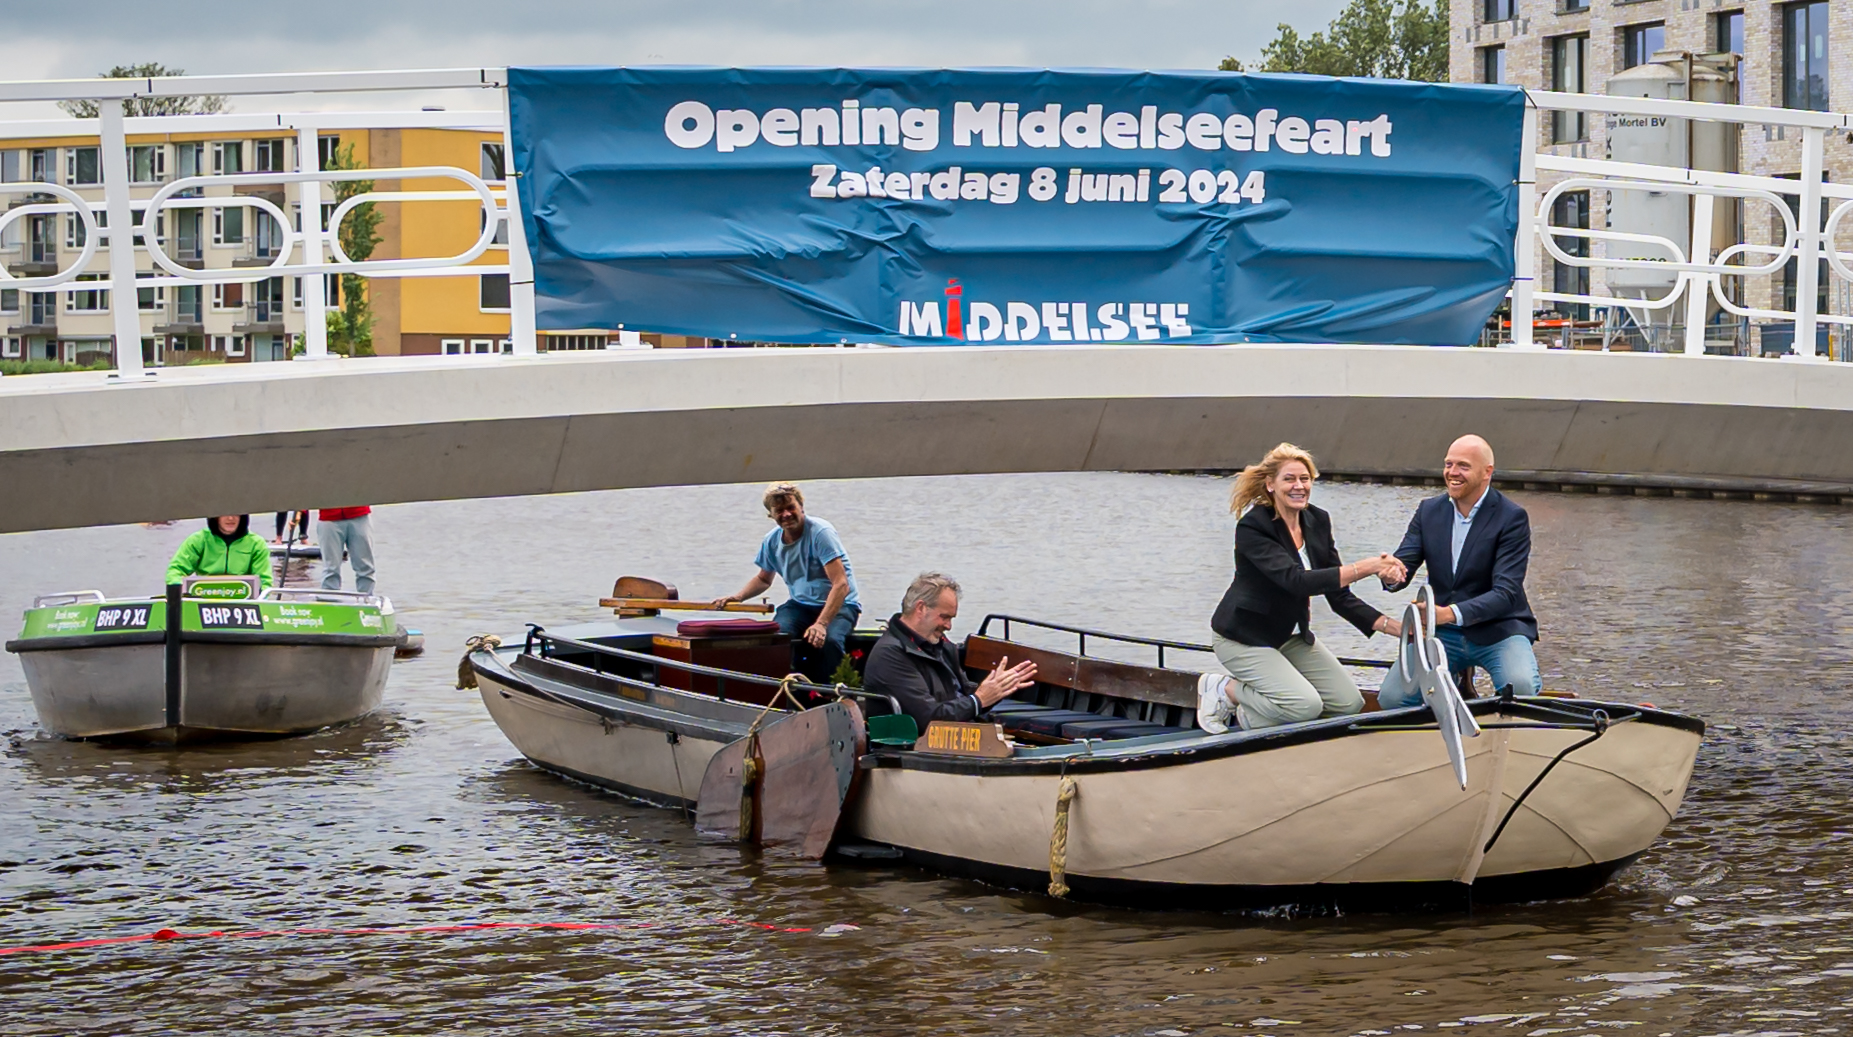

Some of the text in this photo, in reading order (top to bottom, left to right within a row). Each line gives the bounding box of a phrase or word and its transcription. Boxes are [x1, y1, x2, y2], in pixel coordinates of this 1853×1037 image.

[664, 99, 1393, 158] Opening Middelseefeart
[1618, 117, 1648, 128] Mortel
[1650, 117, 1667, 128] BV
[810, 164, 1266, 205] Zaterdag 8 juni 2024
[96, 608, 147, 628] BHP 9 XL
[201, 607, 261, 626] BHP 9 XL
[928, 725, 982, 752] GRUTTE PIER
